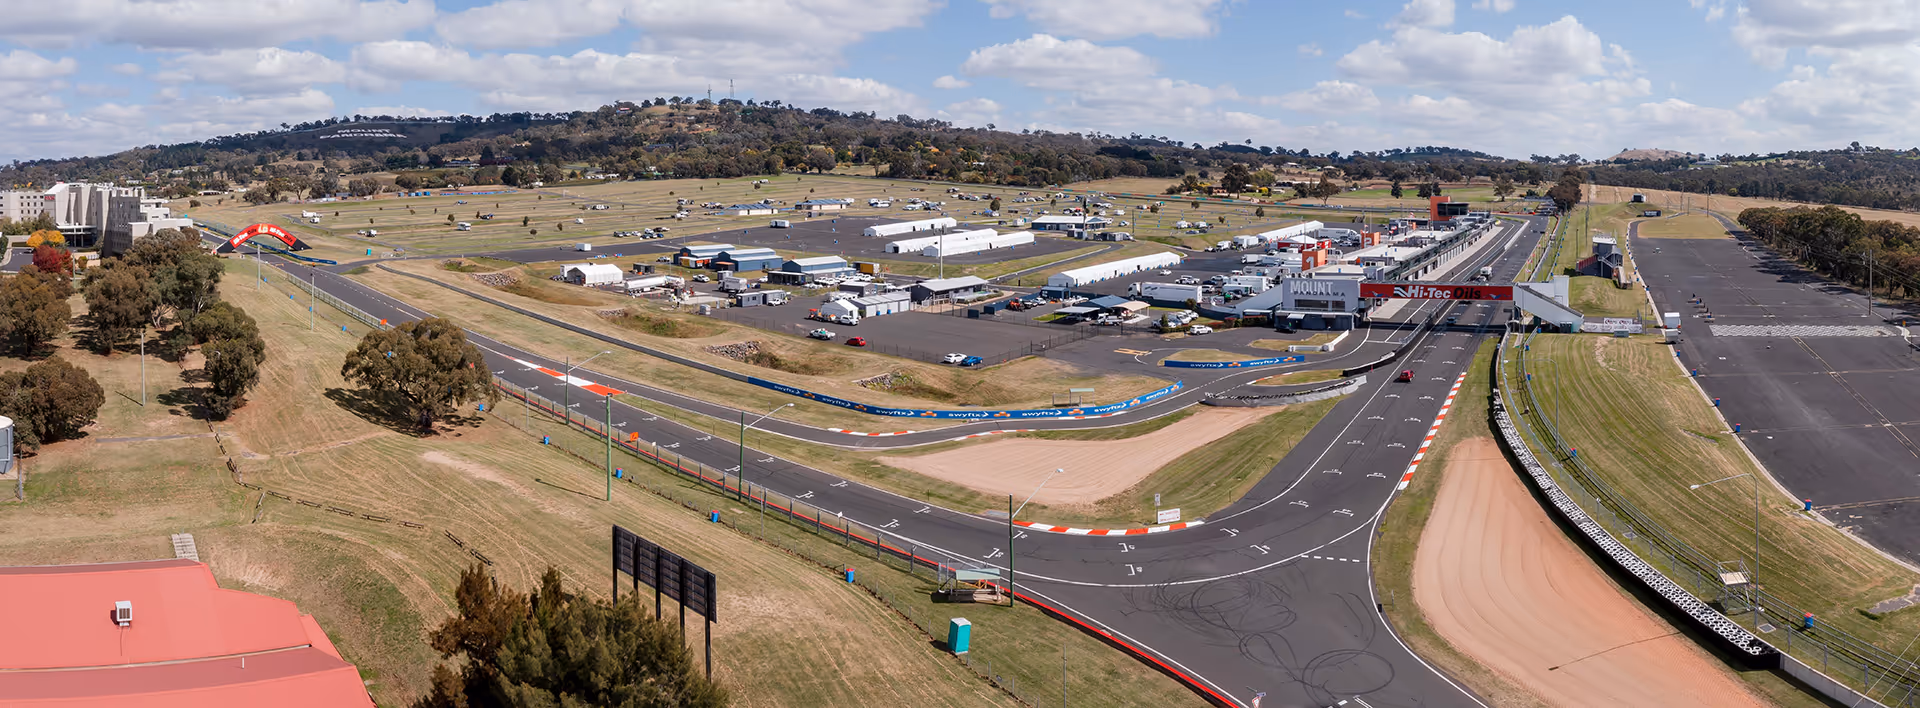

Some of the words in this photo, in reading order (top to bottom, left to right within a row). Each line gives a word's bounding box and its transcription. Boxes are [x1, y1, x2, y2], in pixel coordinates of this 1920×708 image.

[1364, 238, 1372, 249] 2
[1306, 256, 1314, 269] 1
[1290, 281, 1333, 294] MOUNT
[1407, 285, 1451, 299] Hi-Tec
[1453, 287, 1481, 300] Oils
